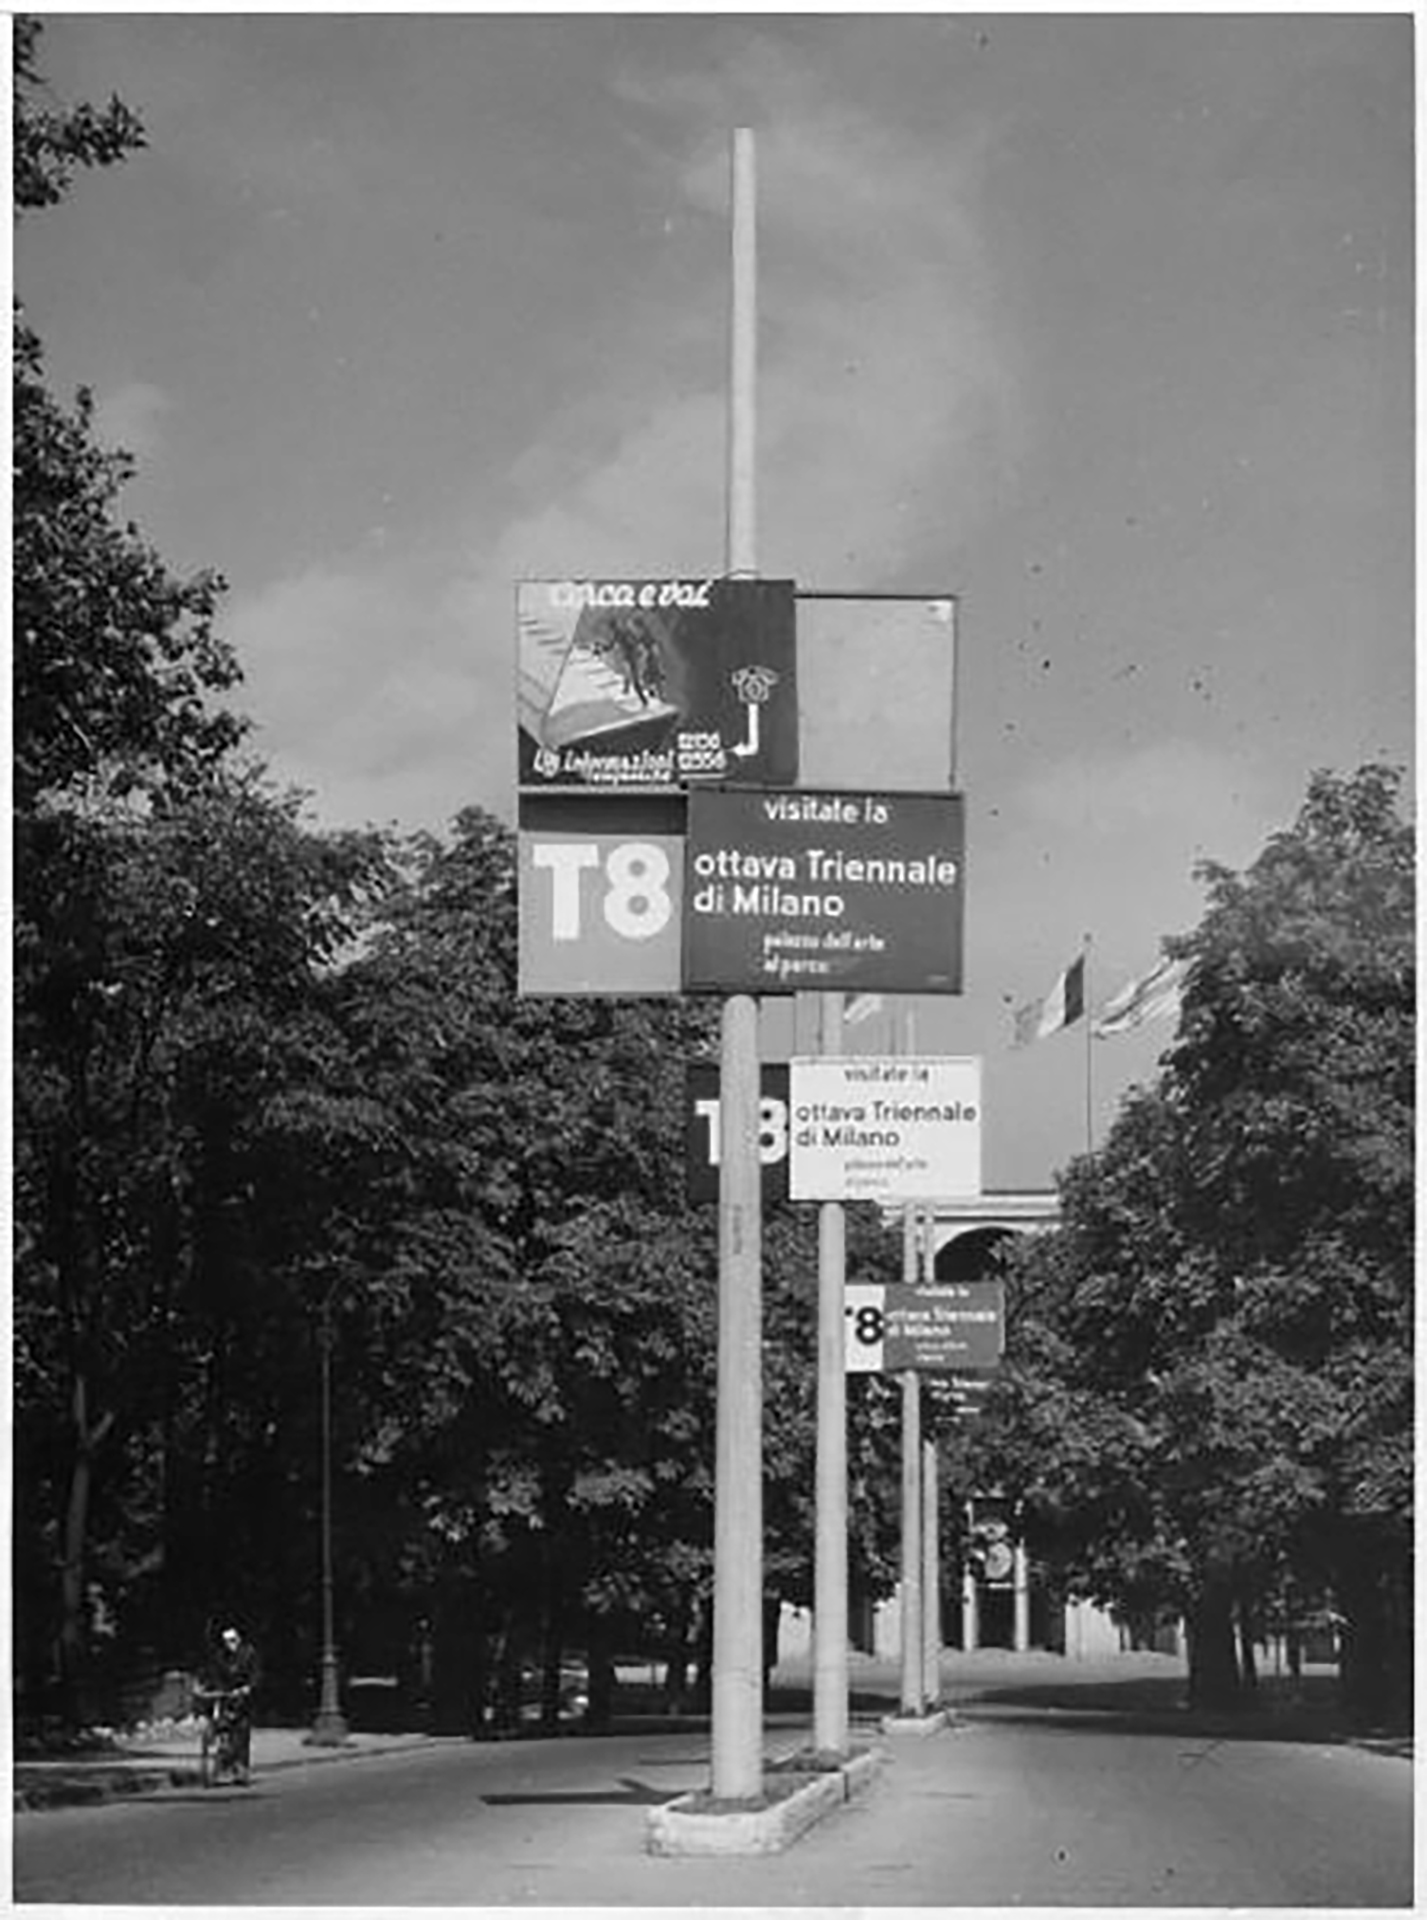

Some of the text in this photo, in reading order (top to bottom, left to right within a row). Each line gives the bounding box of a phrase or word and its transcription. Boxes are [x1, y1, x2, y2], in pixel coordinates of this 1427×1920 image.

[864, 797, 889, 824] la
[694, 849, 957, 885] ottava Triennale
[532, 841, 673, 940] T8
[694, 883, 845, 916] di Milano
[795, 1100, 977, 1122] ottava Triennale
[796, 1125, 901, 1147] di Milano
